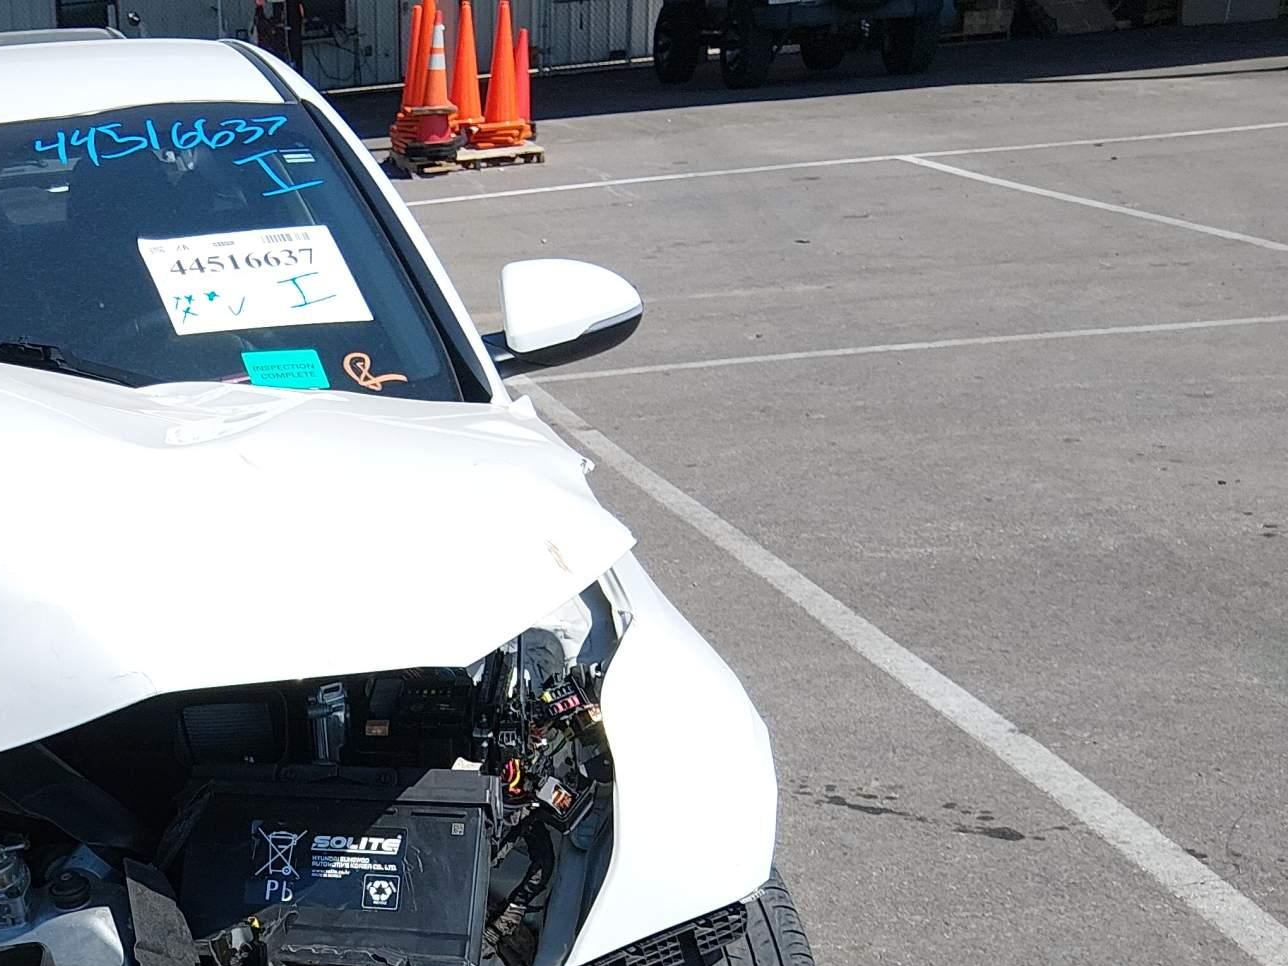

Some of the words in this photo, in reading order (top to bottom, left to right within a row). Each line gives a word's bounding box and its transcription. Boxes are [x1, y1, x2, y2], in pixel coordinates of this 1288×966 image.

[35, 116, 288, 167] 44516637
[170, 248, 313, 275] 44516637
[253, 362, 315, 372] INSPECTION
[261, 371, 316, 380] COMPLETE
[312, 835, 402, 853] SOLITE
[265, 880, 293, 901] Pb
